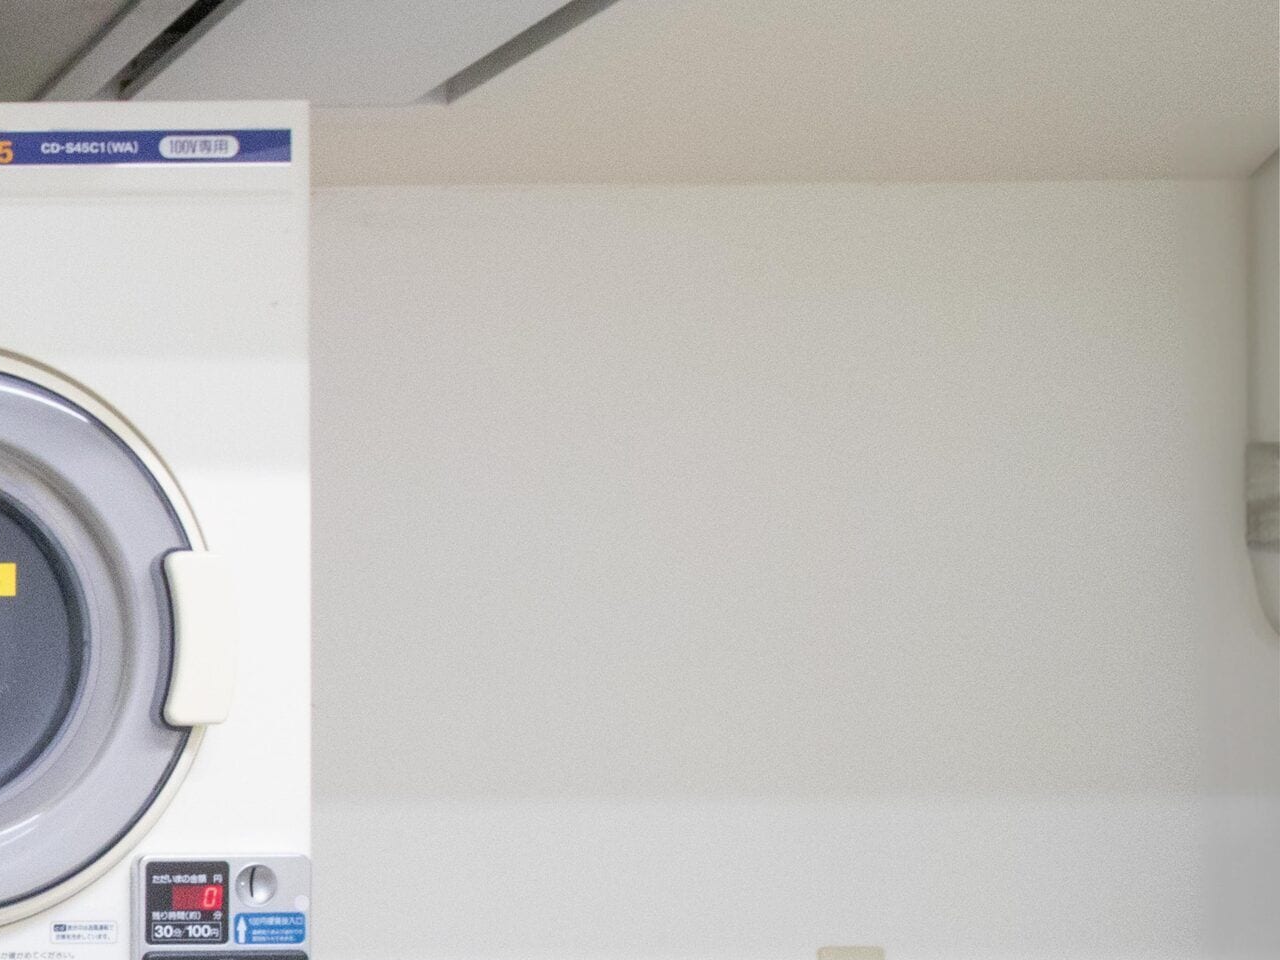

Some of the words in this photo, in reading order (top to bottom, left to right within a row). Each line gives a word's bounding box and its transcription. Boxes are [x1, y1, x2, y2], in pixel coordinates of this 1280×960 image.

[40, 141, 139, 155] CD-S45C1(WA)
[213, 875, 223, 884] 円
[203, 887, 218, 908] 0
[213, 912, 223, 920] 分
[154, 925, 220, 938] 30分/100円
